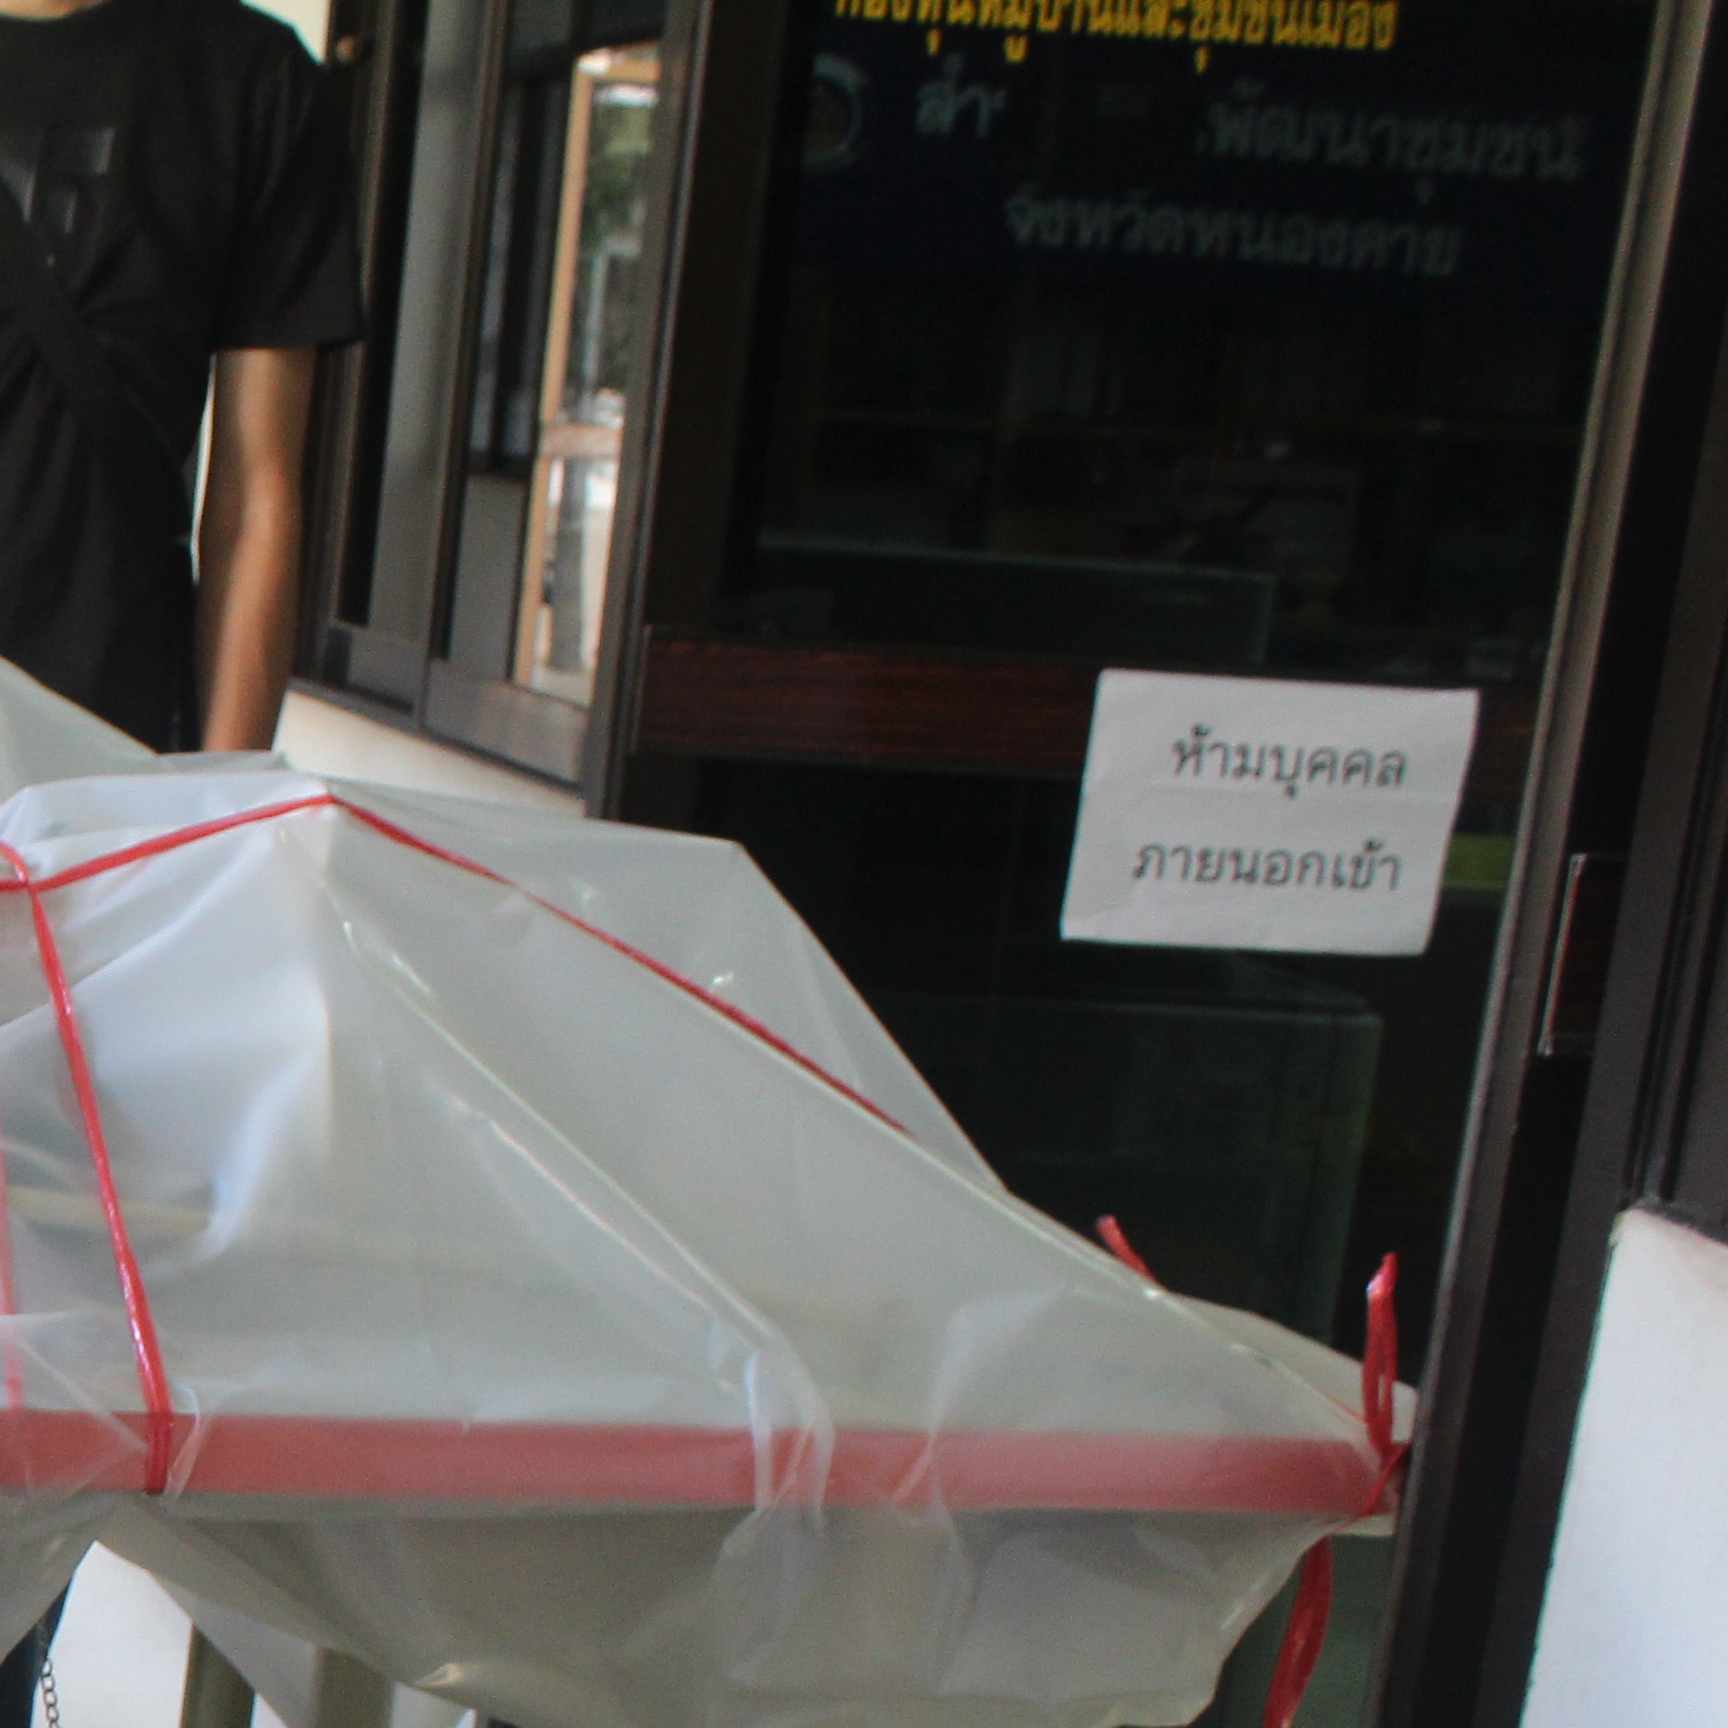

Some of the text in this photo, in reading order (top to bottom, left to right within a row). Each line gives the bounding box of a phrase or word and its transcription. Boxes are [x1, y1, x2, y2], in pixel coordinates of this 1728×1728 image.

[1172, 725, 1407, 798] ห้ามบุคคล
[1131, 840, 1401, 892] ภายนอกเข้า
